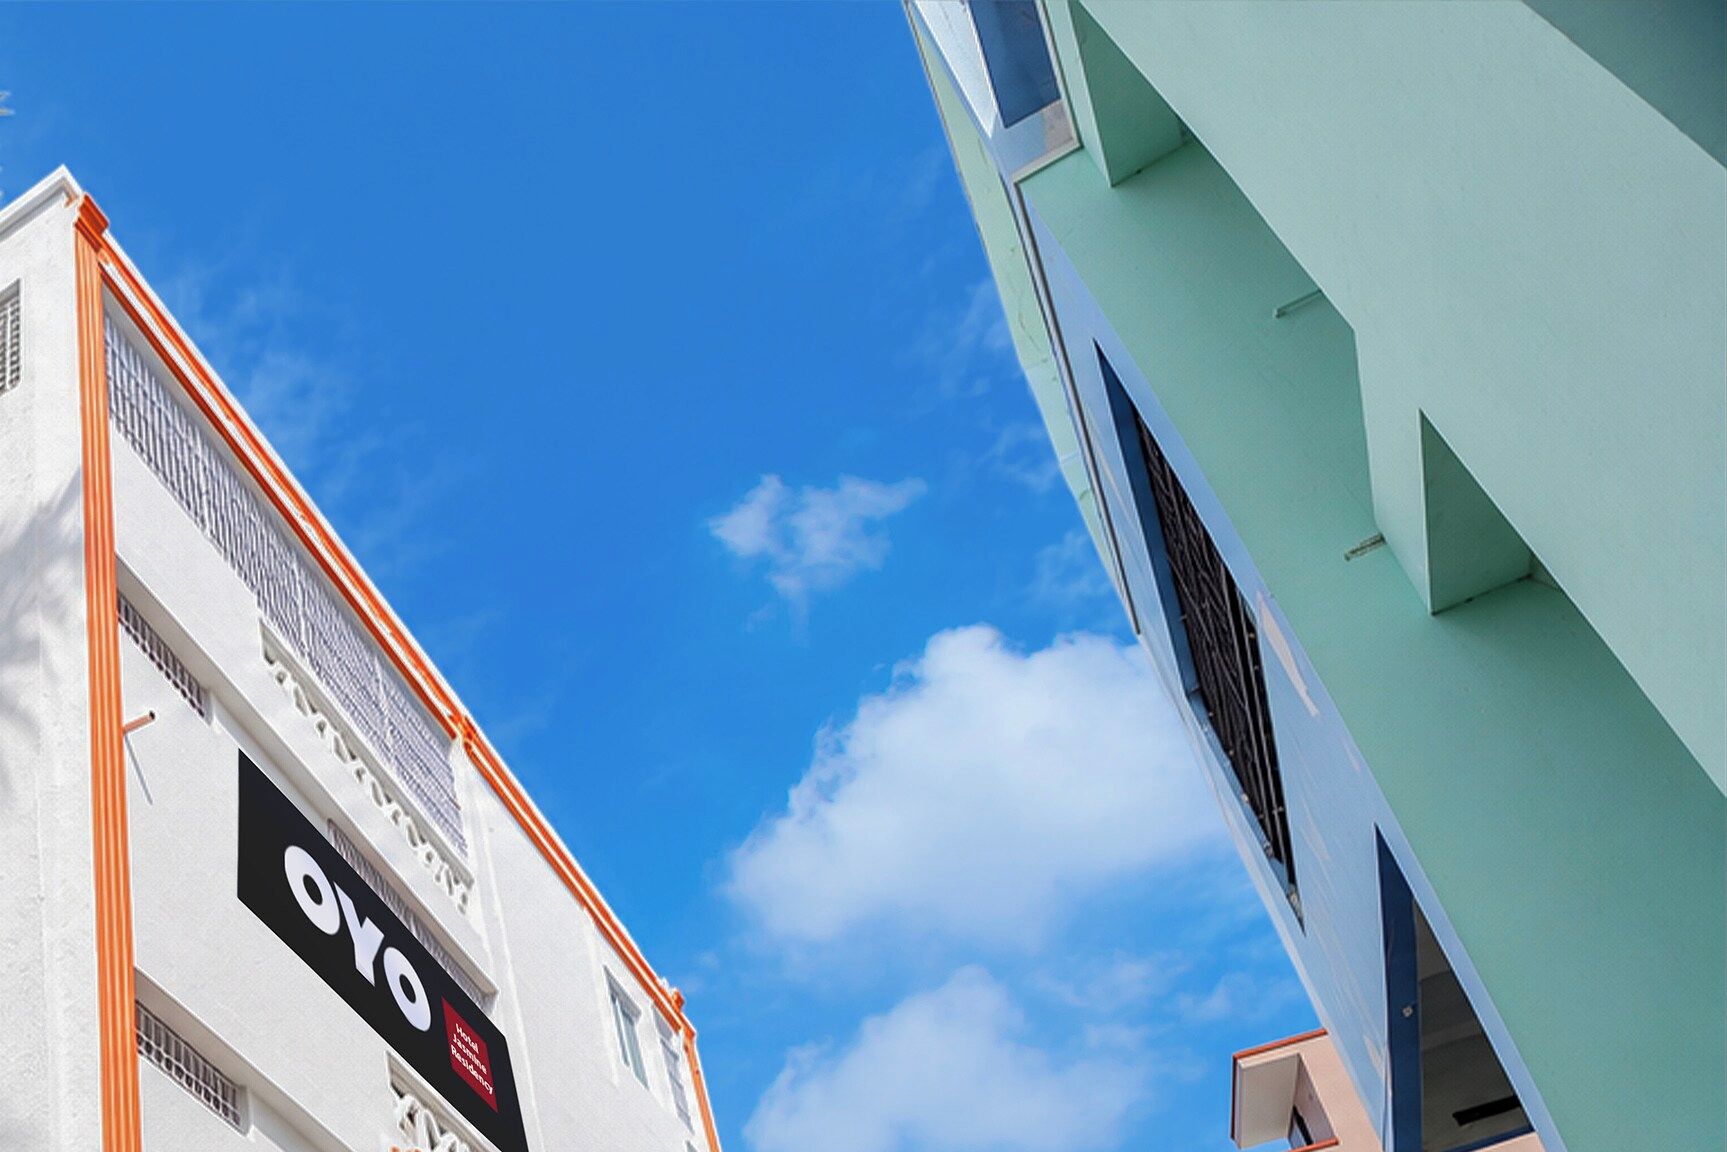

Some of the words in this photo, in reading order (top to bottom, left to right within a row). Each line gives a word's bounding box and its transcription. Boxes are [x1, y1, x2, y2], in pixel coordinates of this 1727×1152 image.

[284, 845, 431, 1032] OYO
[453, 1033, 487, 1074] Jasmine
[455, 1023, 479, 1054] Hotel
[451, 1044, 493, 1095] Residency
